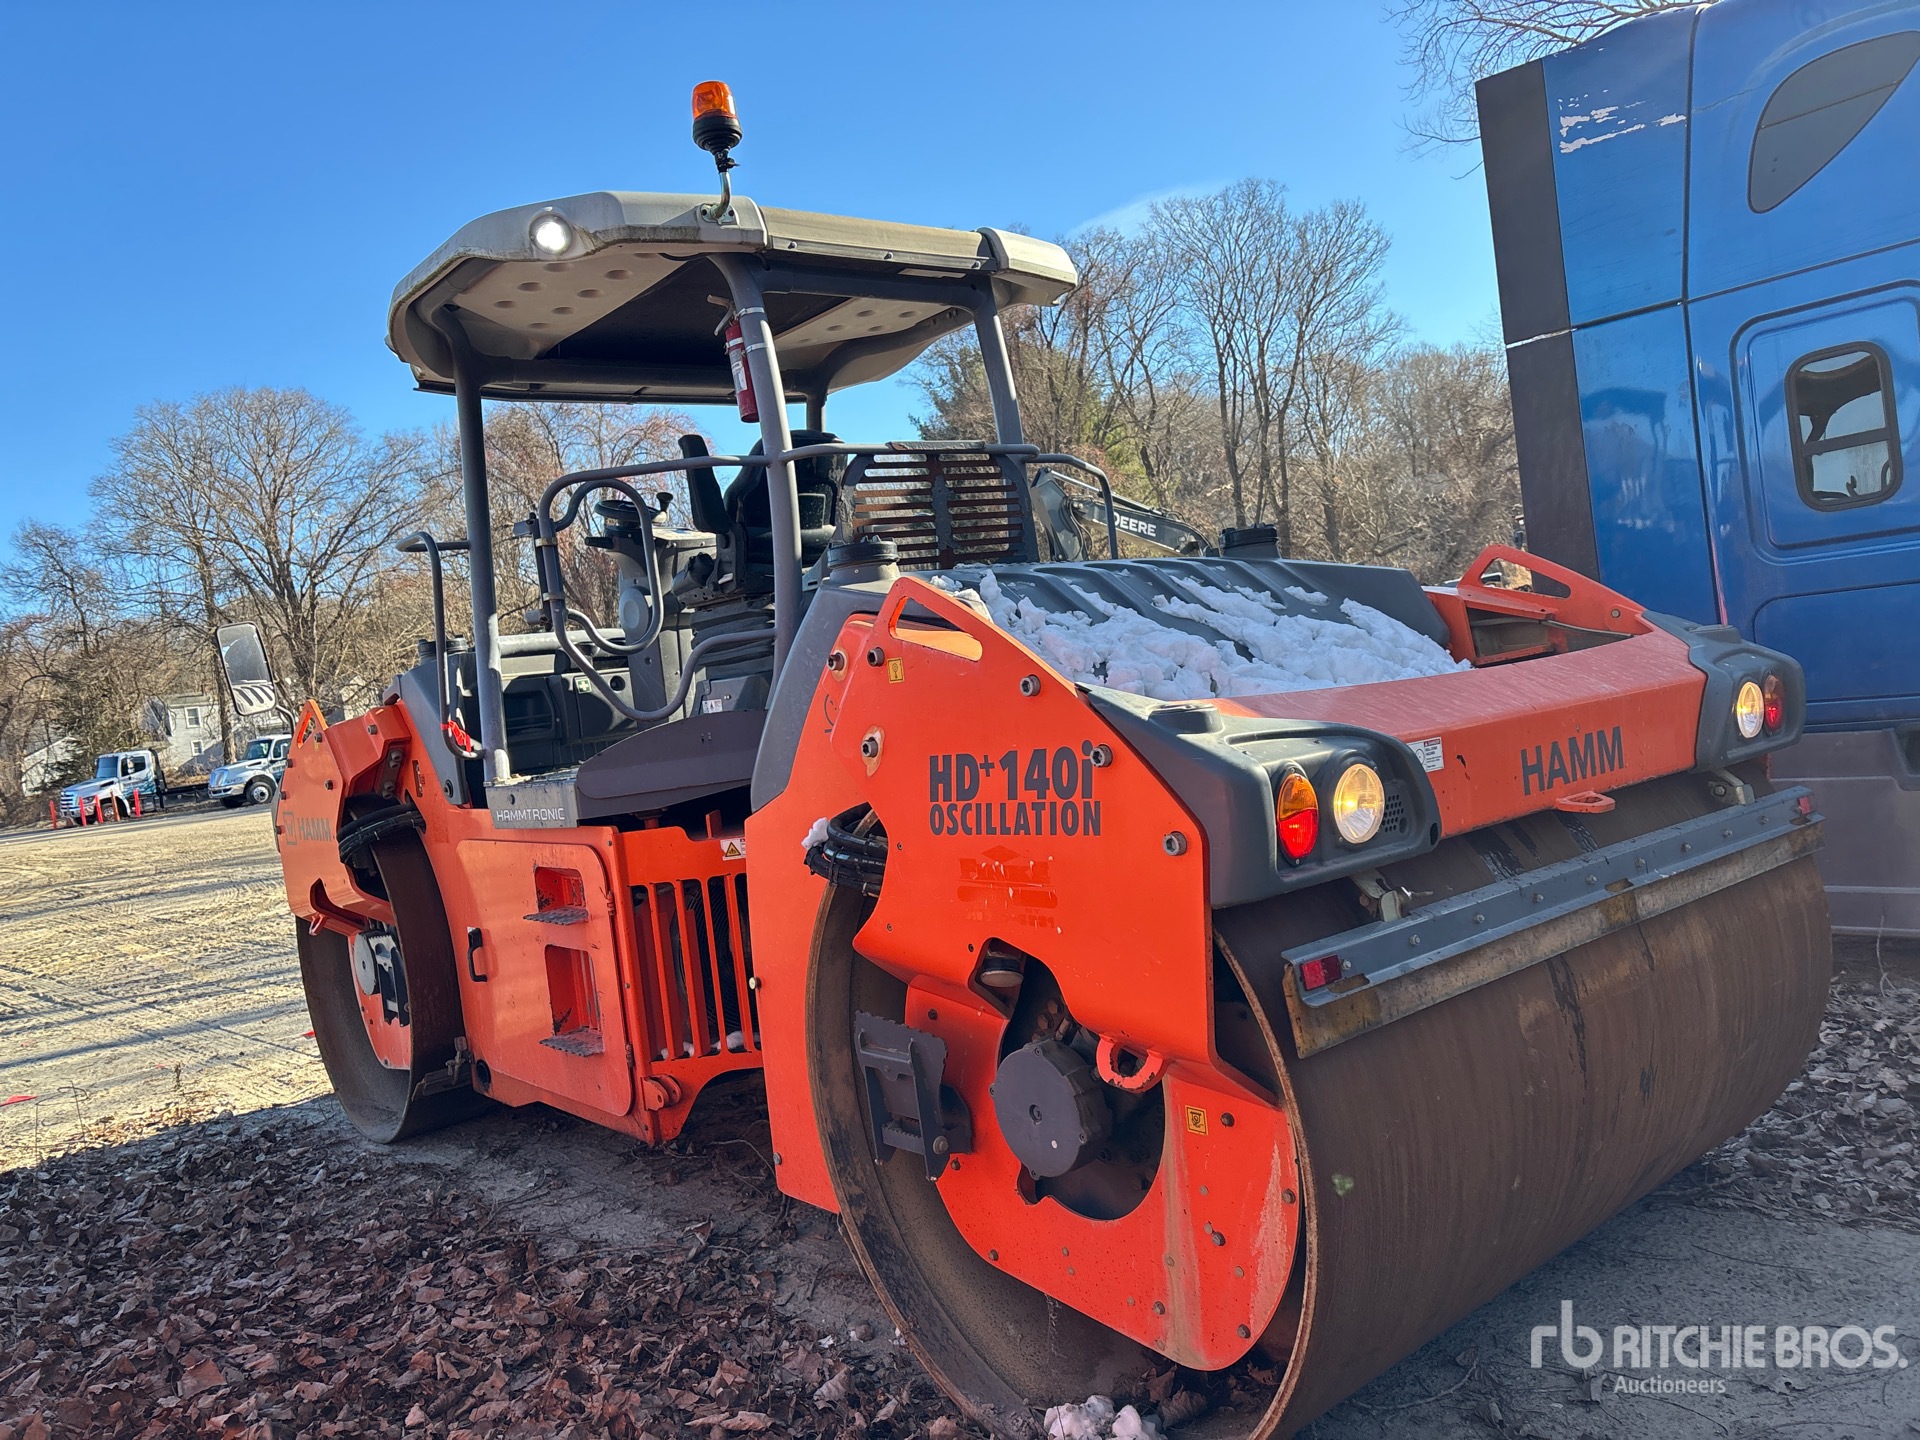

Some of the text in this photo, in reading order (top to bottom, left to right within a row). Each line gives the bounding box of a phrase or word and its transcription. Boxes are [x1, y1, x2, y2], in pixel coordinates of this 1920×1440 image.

[1114, 511, 1157, 538] DEERE
[1520, 726, 1624, 796] HAMM
[496, 807, 566, 822] HAMMTRONIC
[929, 801, 1101, 836] OSCILLATION
[297, 817, 332, 842] HAMM
